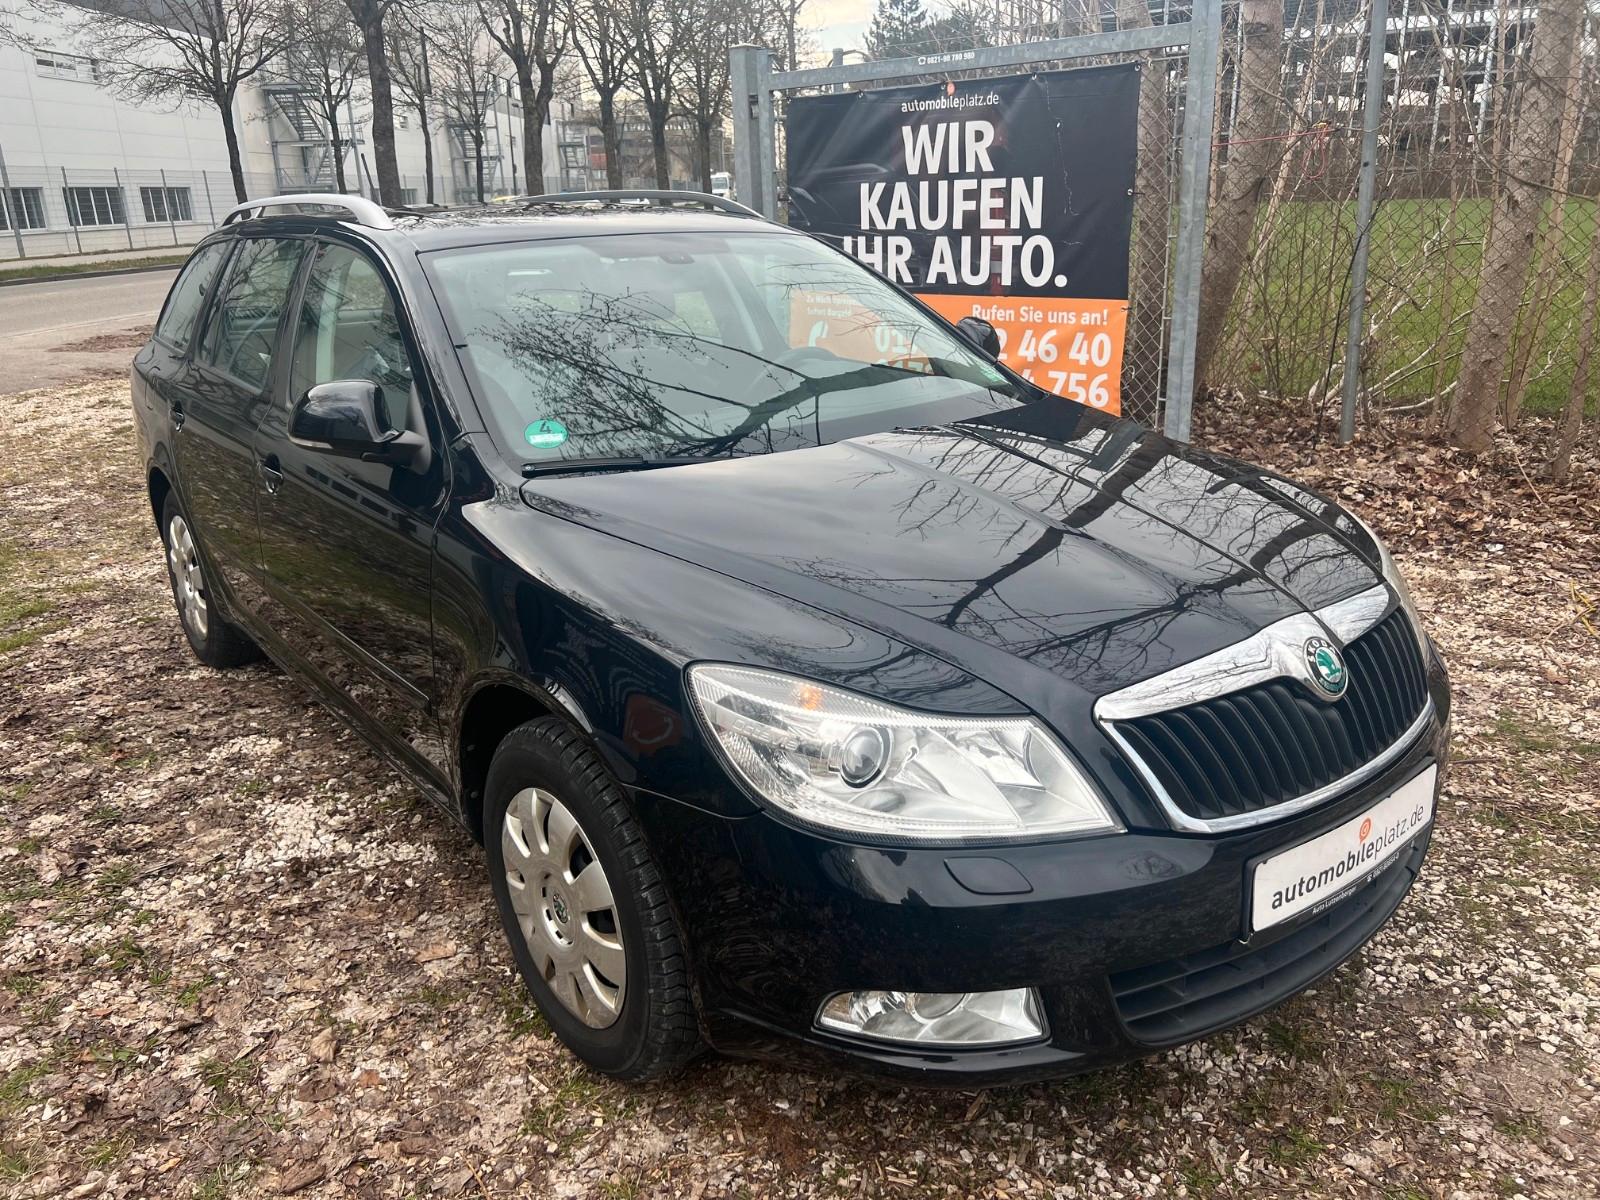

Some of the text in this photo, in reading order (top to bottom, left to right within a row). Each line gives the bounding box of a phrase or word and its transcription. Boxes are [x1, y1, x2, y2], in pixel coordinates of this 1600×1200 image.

[901, 91, 999, 112] automobileplatz.de
[902, 120, 995, 175] WIR
[860, 176, 1044, 231] KAUFEN
[926, 235, 1068, 287] AUTO.
[972, 304, 1108, 326] Rufen Sie uns an!
[1018, 329, 1059, 363] 46
[1069, 332, 1112, 368] 40
[1048, 371, 1109, 408] 756
[540, 420, 552, 434] 4
[1271, 804, 1424, 910] automobileplatz.de
